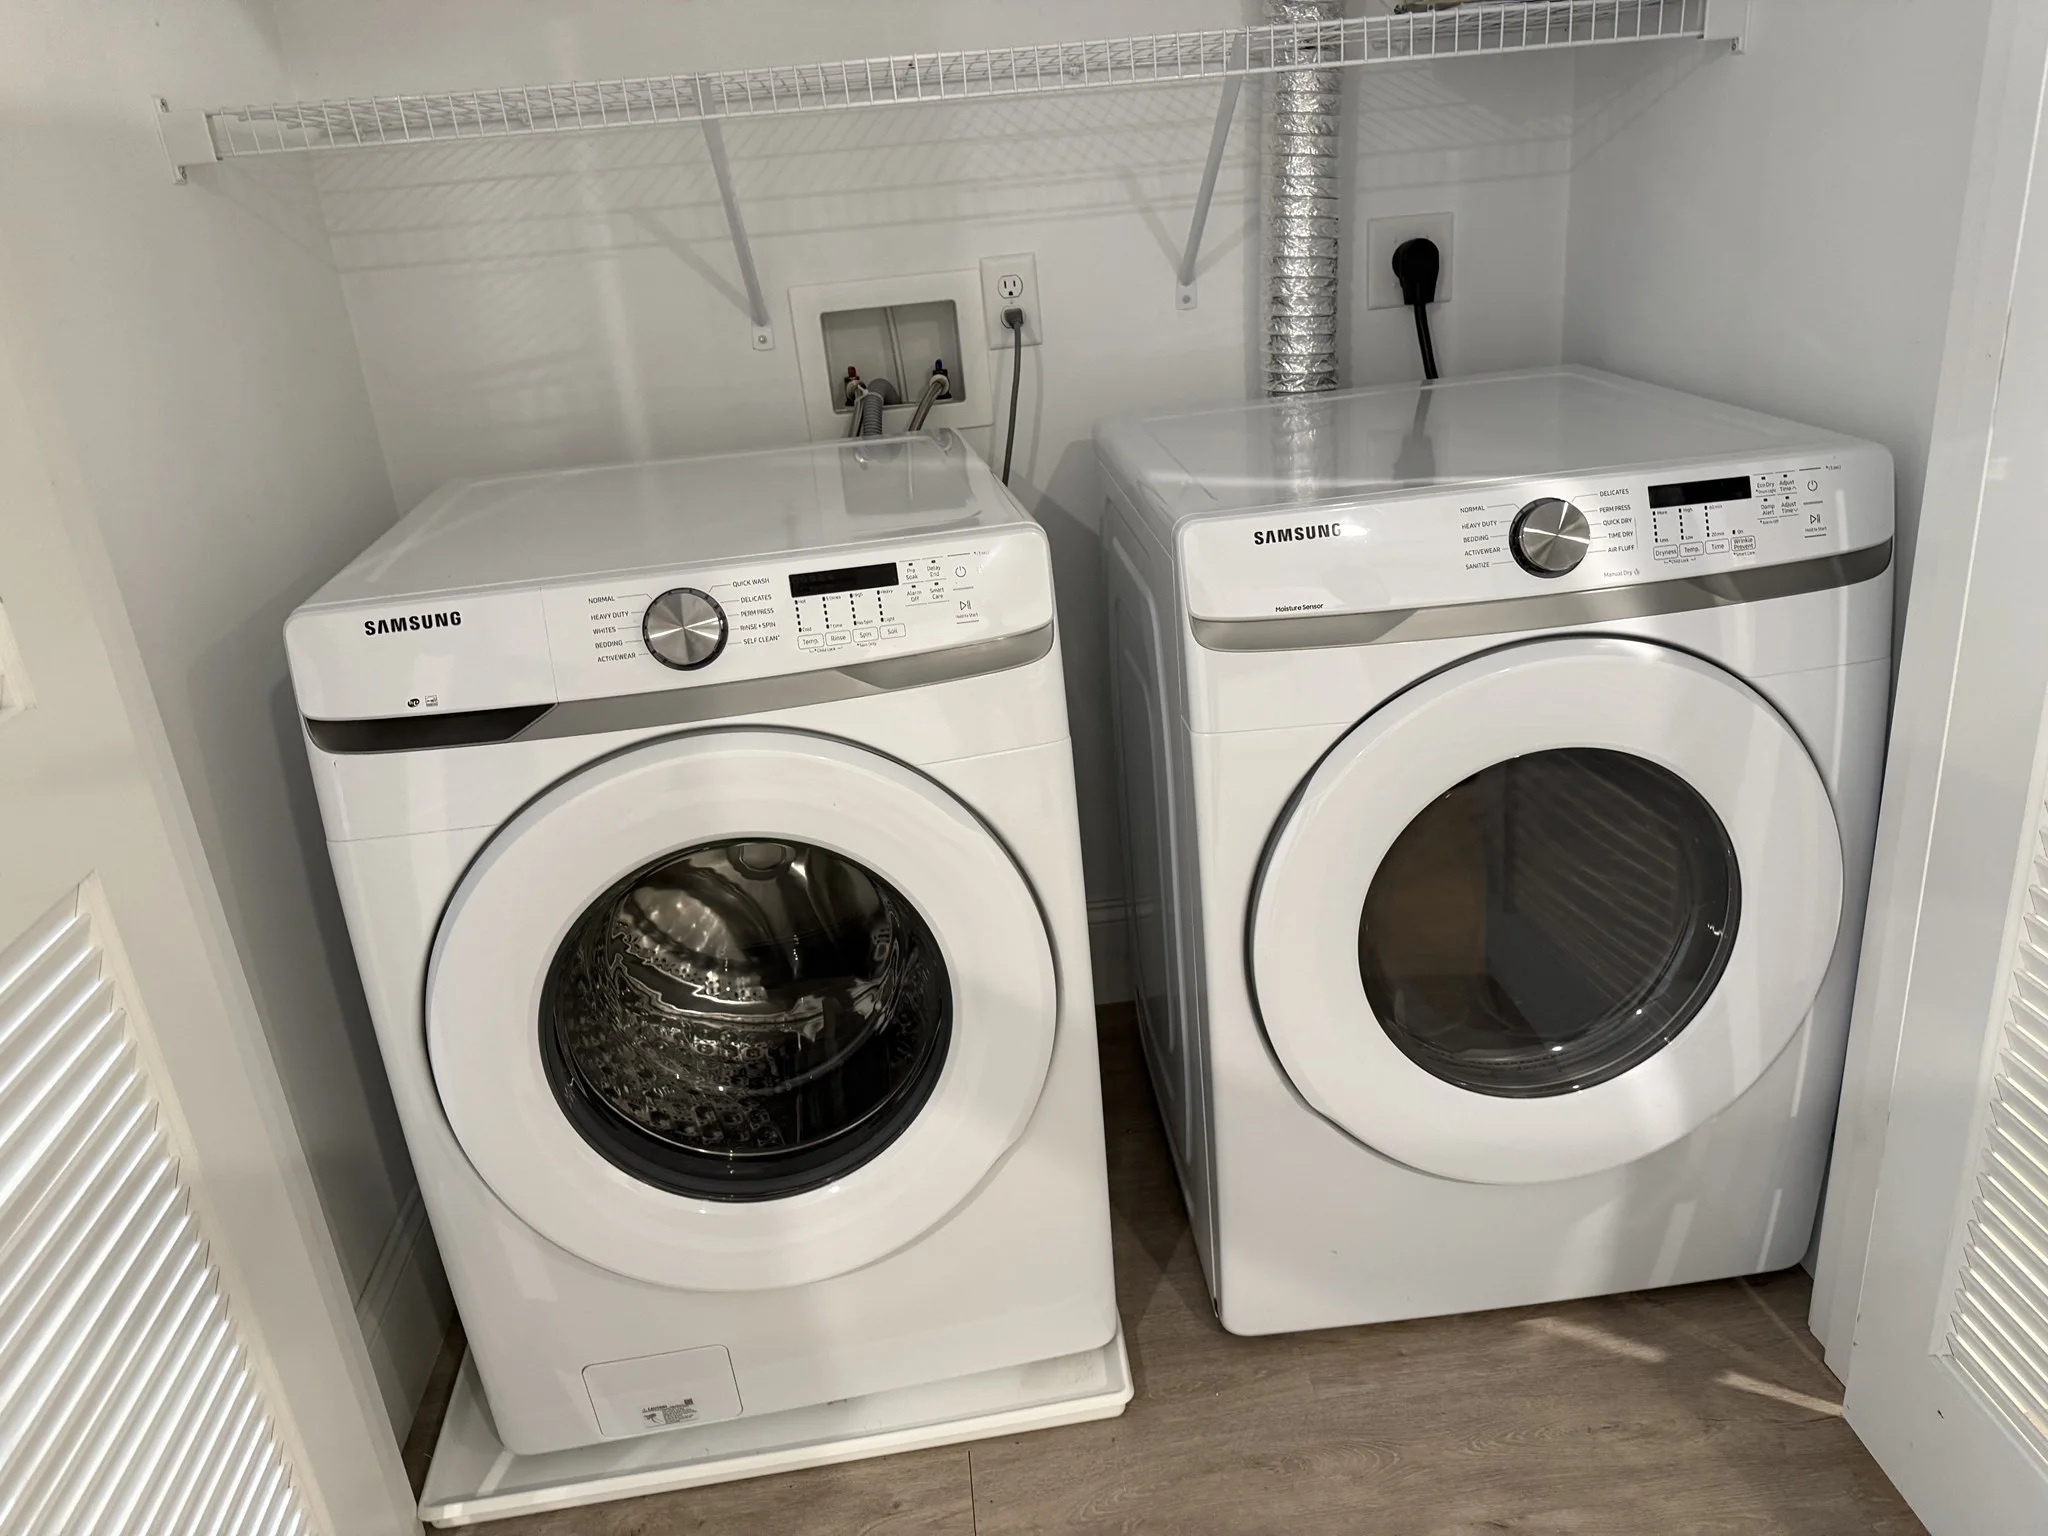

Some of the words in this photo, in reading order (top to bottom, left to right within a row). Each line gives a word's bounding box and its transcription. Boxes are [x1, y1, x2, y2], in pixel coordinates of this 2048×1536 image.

[1599, 488, 1629, 497] DELICATES
[1254, 523, 1341, 545] SAMSUNG
[1463, 535, 1489, 543] BEDDING
[1465, 547, 1501, 556] ACTIVEWEAR
[1656, 549, 1677, 557] Dryness
[1466, 562, 1490, 570] SANITIZE
[1604, 570, 1622, 578] Manual
[588, 596, 615, 604] NORMAL
[741, 594, 772, 603] DELICATES
[612, 611, 629, 619] DUTY
[364, 611, 462, 636] SAMSUNG
[593, 626, 616, 635] WHITES
[595, 640, 623, 649] BEDDING
[597, 652, 636, 663] ACTIVEWEAR
